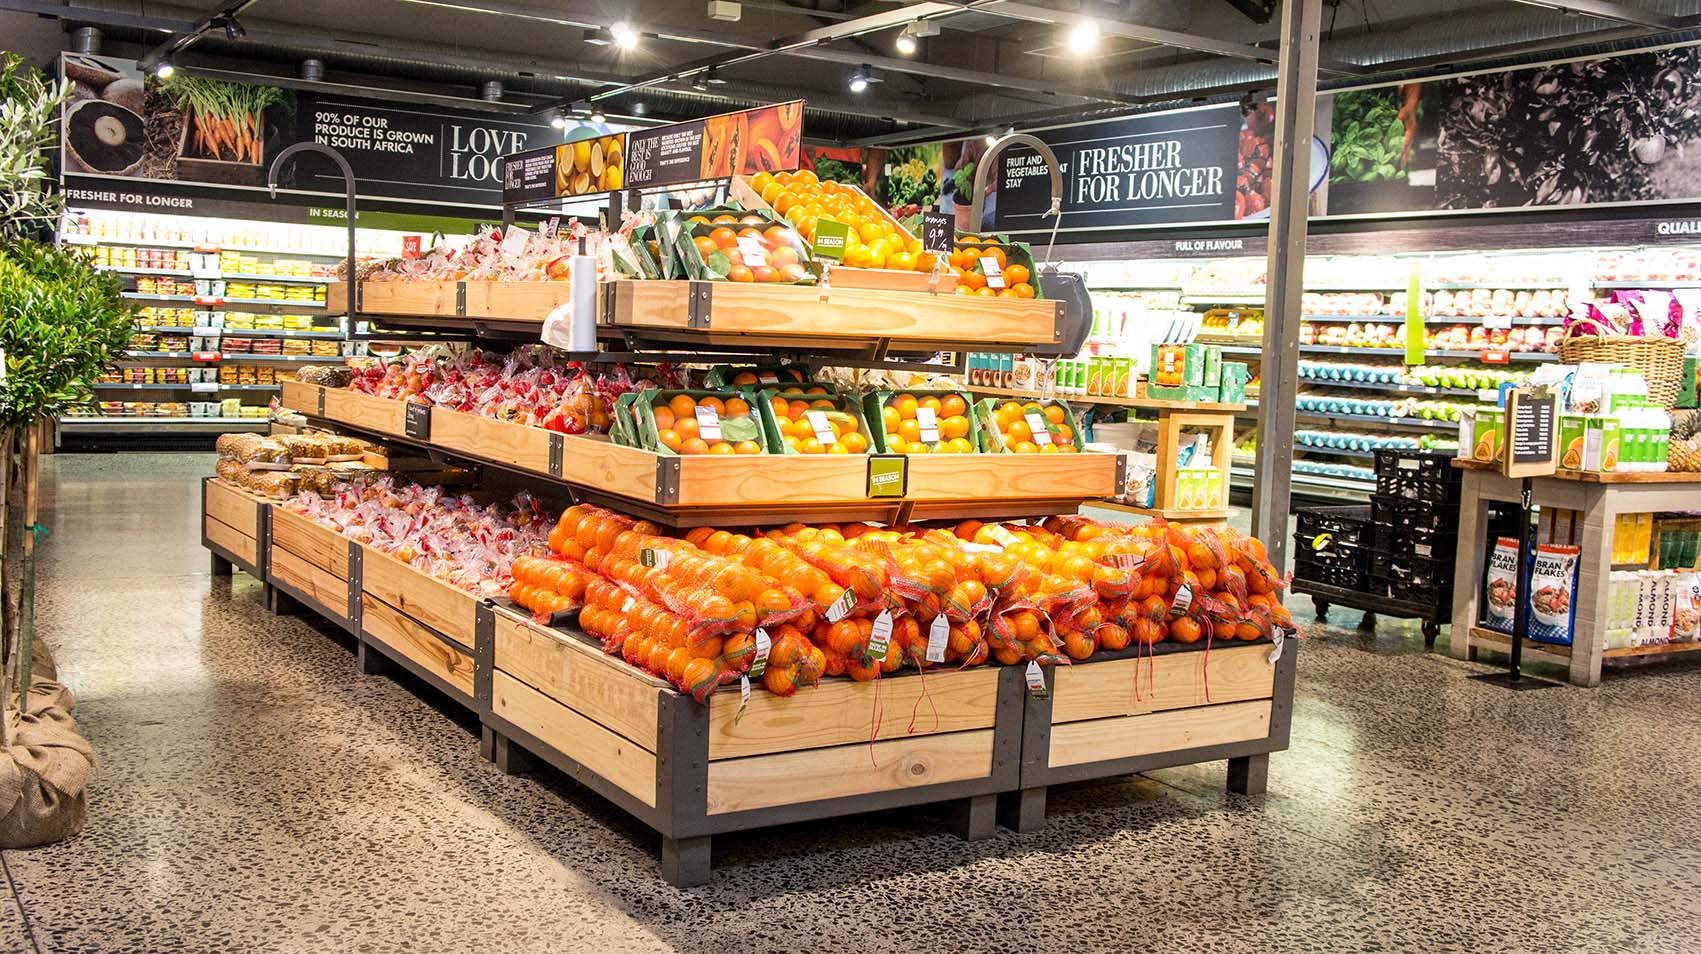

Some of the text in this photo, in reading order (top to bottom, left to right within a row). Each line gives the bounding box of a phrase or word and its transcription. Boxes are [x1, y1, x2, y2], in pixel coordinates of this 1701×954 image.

[315, 112, 388, 129] 90% OF OUR
[315, 124, 434, 144] PRODUCE IS GROWN
[450, 125, 528, 155] LOVE
[315, 135, 414, 154] IN SOUTH AFRICA
[1006, 155, 1043, 168] FRUIT AND
[1078, 140, 1182, 176] FRESHER
[1006, 165, 1049, 178] VEGETABLES
[1005, 178, 1023, 189] STAY
[1077, 166, 1223, 203] FOR LONGER
[67, 189, 193, 208] FRESHER FOR LONGER
[309, 208, 320, 217] IN
[1175, 239, 1243, 251] FULL OF FLAVOUR
[1535, 567, 1565, 578] FLAKES
[1536, 560, 1562, 570] BRAN
[1647, 580, 1658, 627] ALMOND
[1661, 580, 1671, 627] ALMOND
